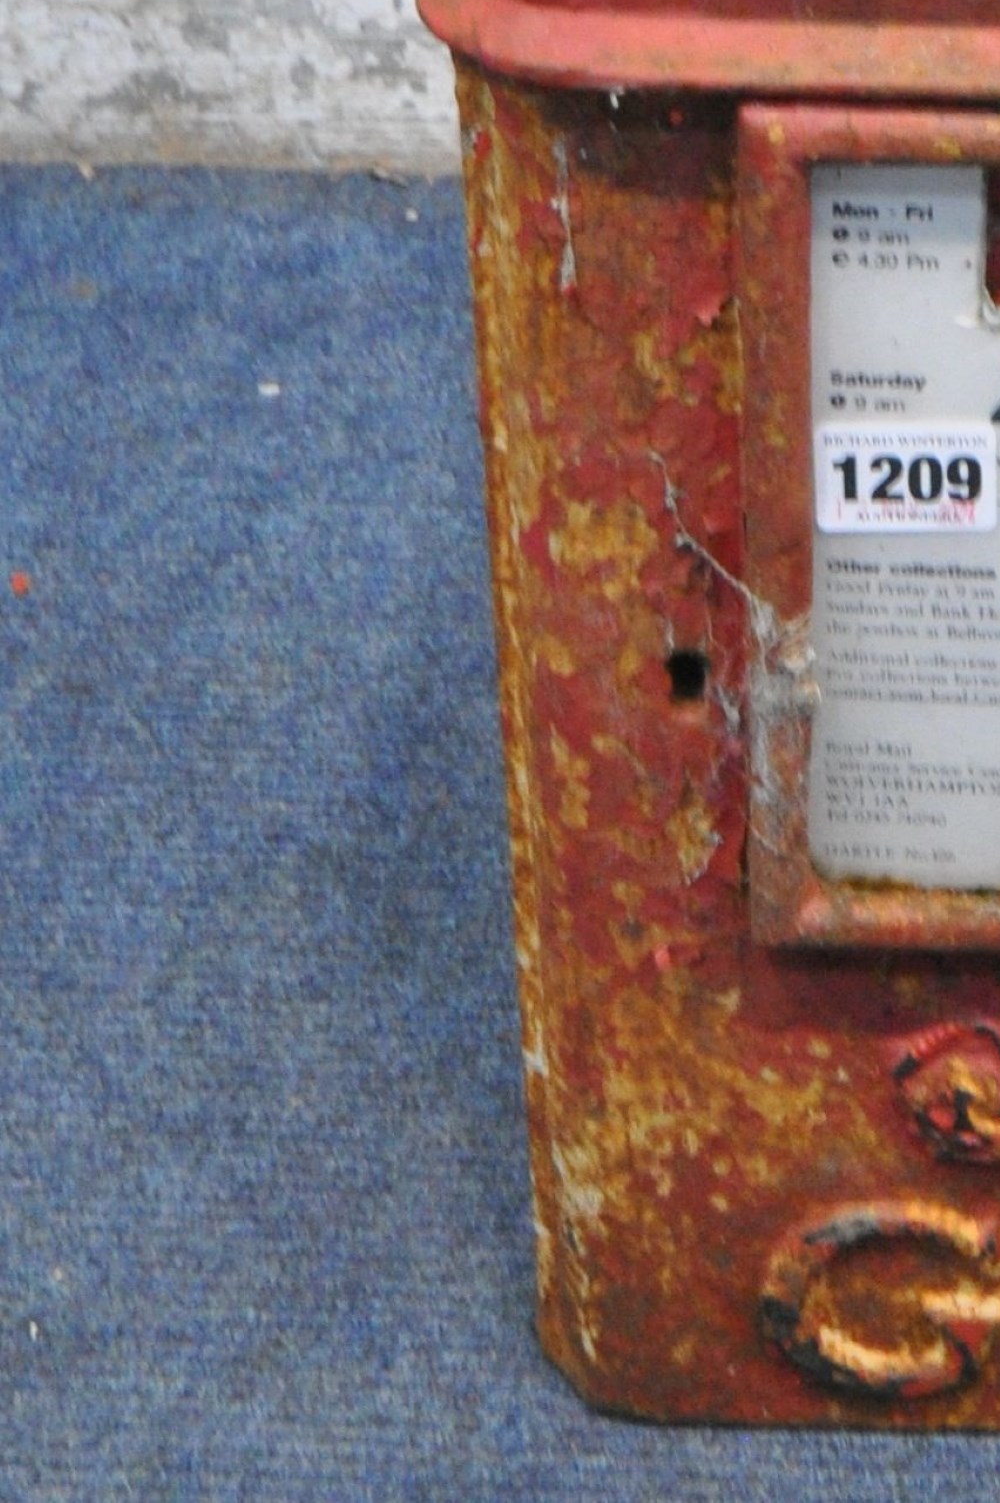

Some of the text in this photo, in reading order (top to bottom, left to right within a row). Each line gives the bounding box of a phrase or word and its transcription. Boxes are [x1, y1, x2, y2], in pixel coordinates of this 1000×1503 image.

[832, 201, 879, 218] Mon
[829, 370, 926, 392] Saturday
[832, 454, 983, 502] 1209
[826, 558, 997, 580] Other collections
